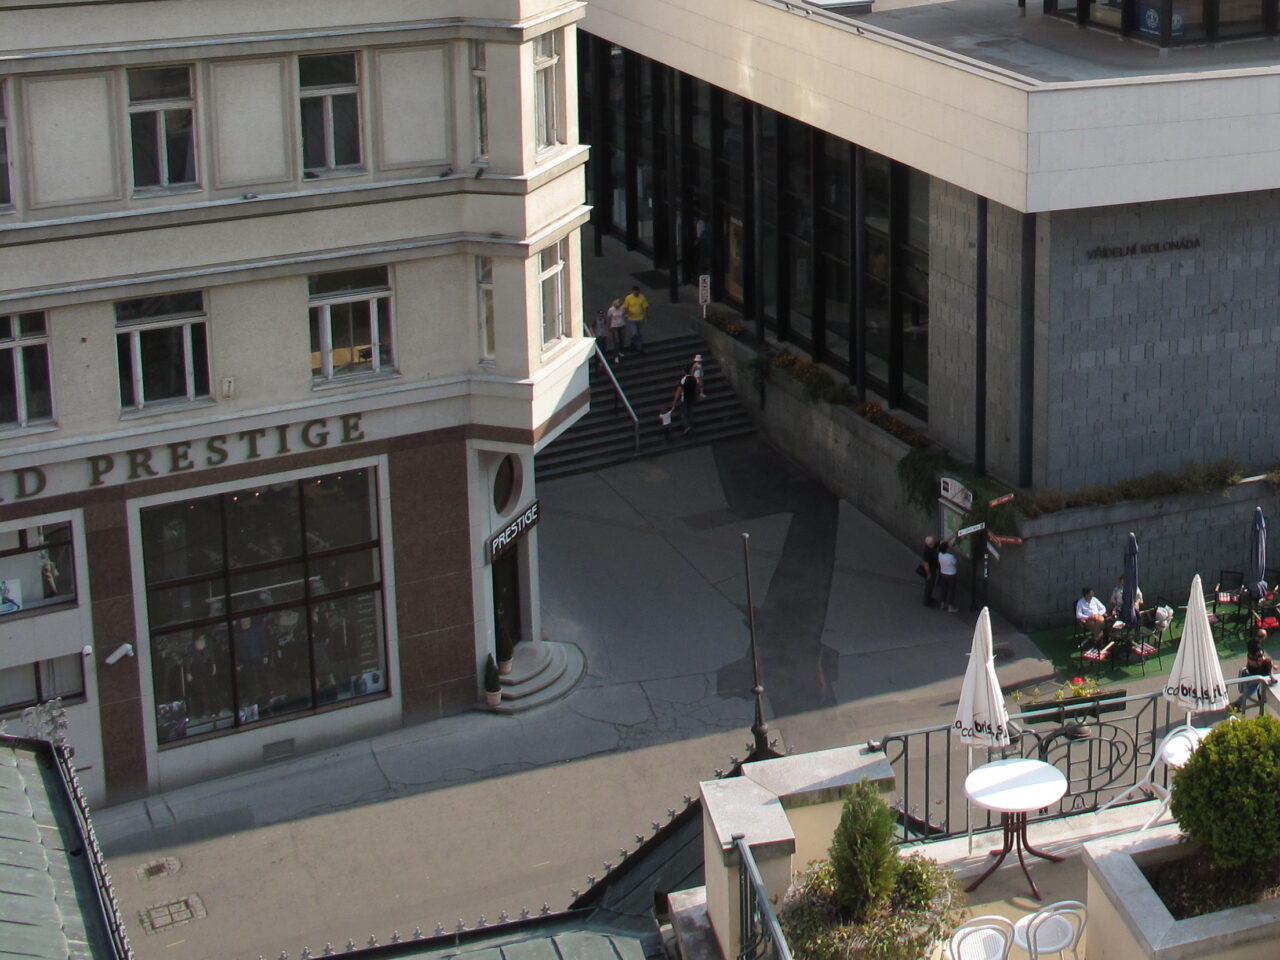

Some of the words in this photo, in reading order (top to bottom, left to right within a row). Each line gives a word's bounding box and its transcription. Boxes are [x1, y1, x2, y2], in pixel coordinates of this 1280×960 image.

[0, 465, 47, 503] D
[87, 414, 365, 487] PRESTIGE
[492, 503, 538, 555] PRESTIGE
